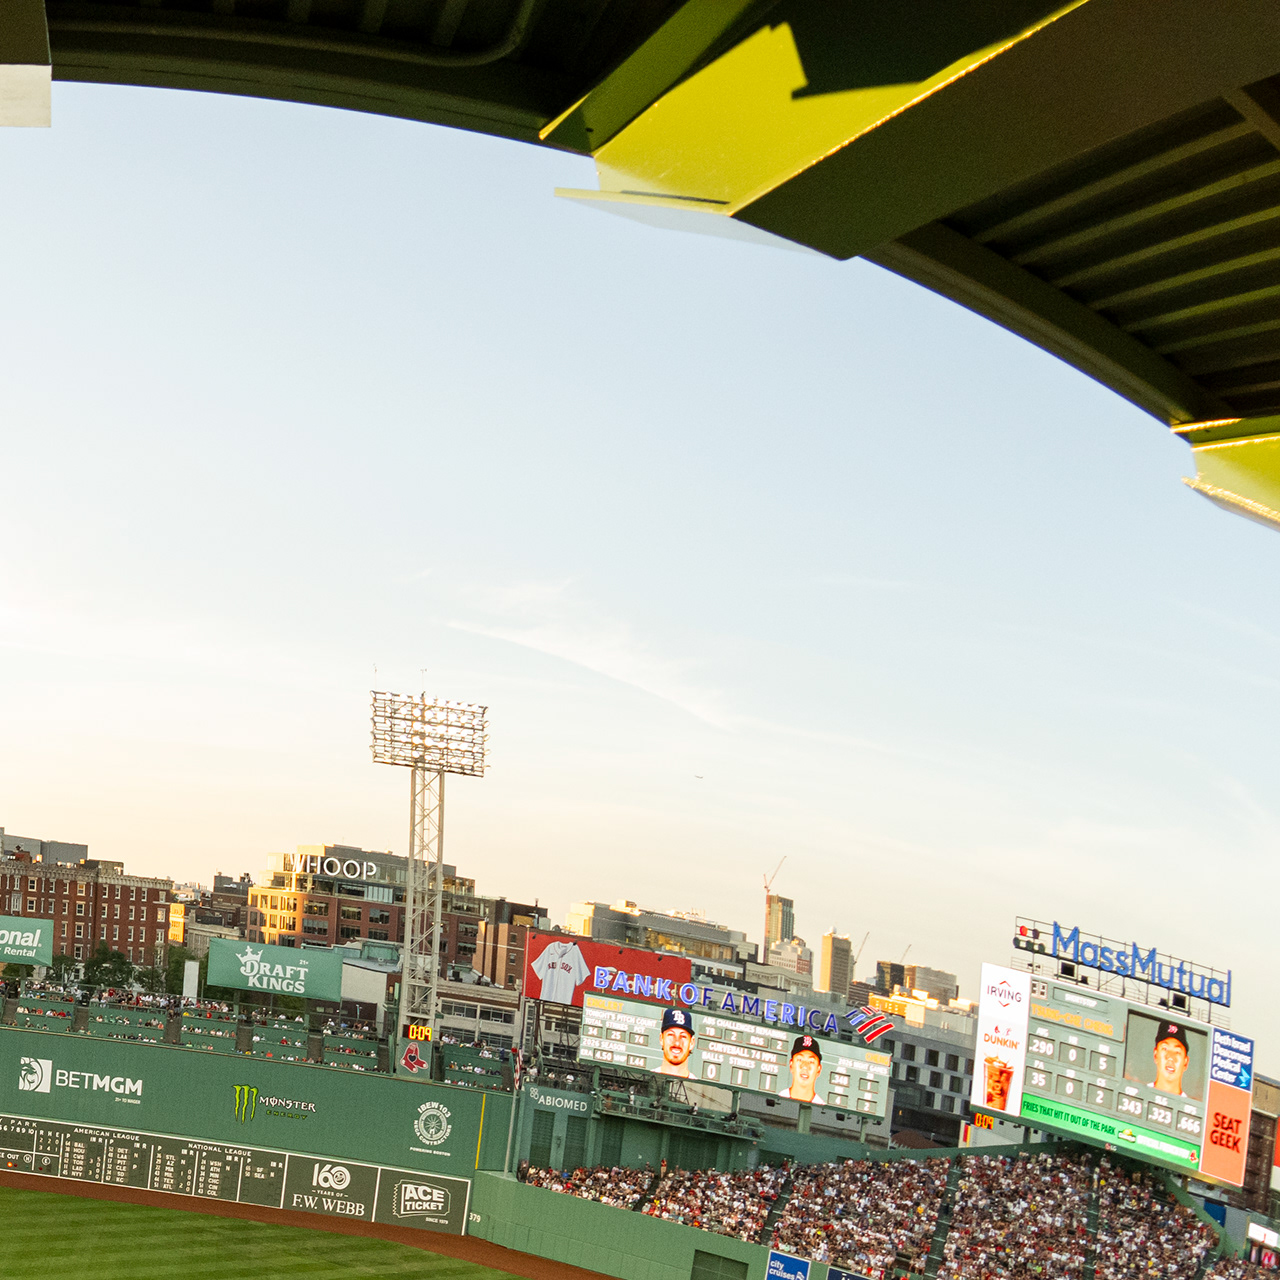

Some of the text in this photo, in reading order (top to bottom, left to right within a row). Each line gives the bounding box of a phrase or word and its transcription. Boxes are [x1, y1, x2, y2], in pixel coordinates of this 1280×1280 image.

[290, 853, 377, 880] WHOOP
[4, 946, 36, 958] Rental
[240, 960, 308, 980] DRAFT
[560, 962, 572, 974] SOX
[1051, 920, 1232, 1008] MassMutual
[248, 974, 306, 994] KINGS
[594, 966, 672, 1000] BANK
[680, 982, 714, 1006] OF
[722, 992, 838, 1034] AMERICA
[987, 986, 1022, 1003] IRVING
[408, 1024, 432, 1041] 0:09
[611, 1031, 621, 1040] 25
[706, 1027, 716, 1036] TB
[731, 1032, 737, 1040] 2
[776, 1041, 782, 1049] 2
[1029, 1039, 1054, 1054] .290
[1099, 1058, 1107, 1070] 5
[56, 1069, 143, 1096] BETMGM
[1031, 1073, 1046, 1086] 35
[538, 1095, 588, 1112] ABIOMED
[1096, 1091, 1104, 1103] 2
[266, 1109, 308, 1120] ENERGY
[417, 1102, 452, 1118] IBEW 103
[1118, 1100, 1142, 1115] .343
[10, 1119, 38, 1128] PARK
[975, 1113, 994, 1130] 0:09
[1022, 1100, 1116, 1135] FRIES THAT HIT IT OUT OF THE PARK
[1148, 1109, 1172, 1124] .323
[1214, 1112, 1242, 1134] SEAT
[74, 1128, 140, 1141] AMERICAN LEAGUE
[1210, 1129, 1241, 1154] GEEK
[188, 1143, 252, 1157] NATIONAL LEAGUE
[312, 1163, 351, 1190] 160
[405, 1184, 444, 1202] ACE
[292, 1194, 365, 1216] F.W. WEBB
[405, 1201, 444, 1211] TICKET
[469, 1212, 481, 1223] 379
[770, 1259, 785, 1271] city
[769, 1268, 796, 1280] cruises
